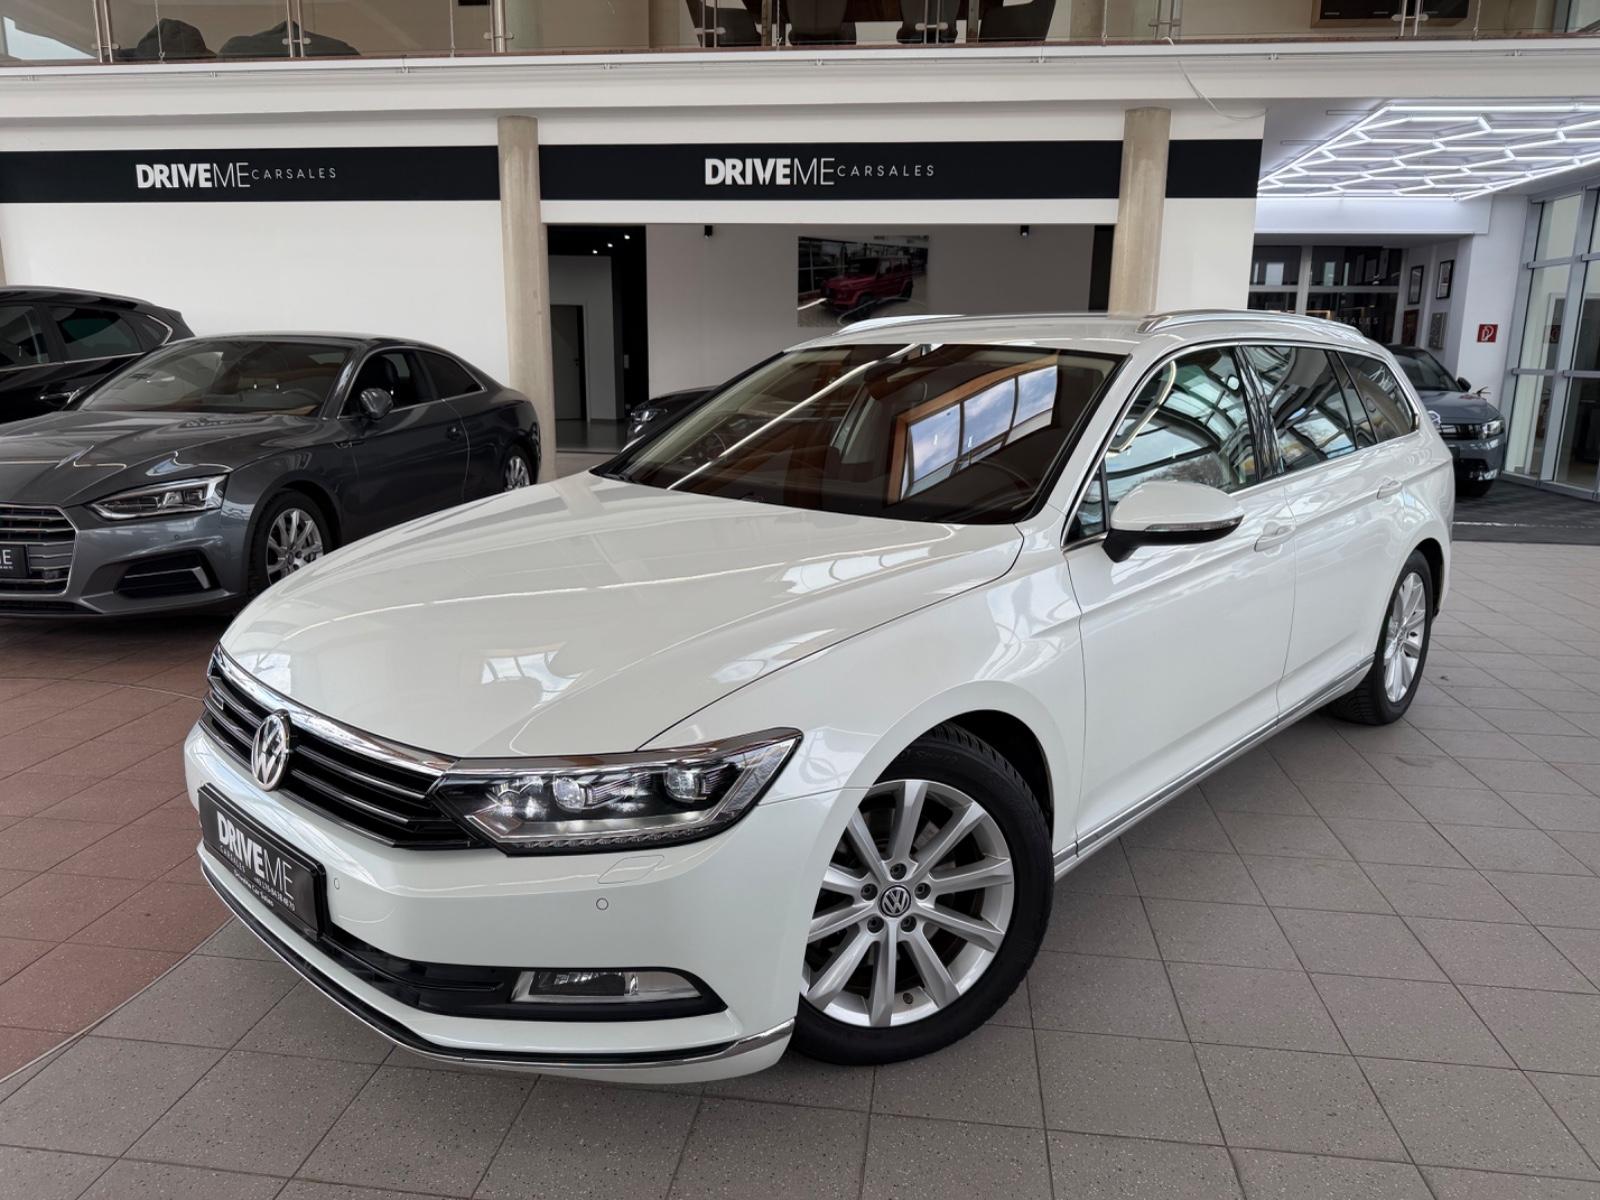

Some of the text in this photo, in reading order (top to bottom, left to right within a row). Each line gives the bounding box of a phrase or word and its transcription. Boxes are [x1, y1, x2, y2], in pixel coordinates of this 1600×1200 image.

[135, 162, 336, 188] DRIVEME CARSALES
[705, 157, 934, 186] DRIVEME CARSALES
[216, 811, 294, 901] DRIVEME
